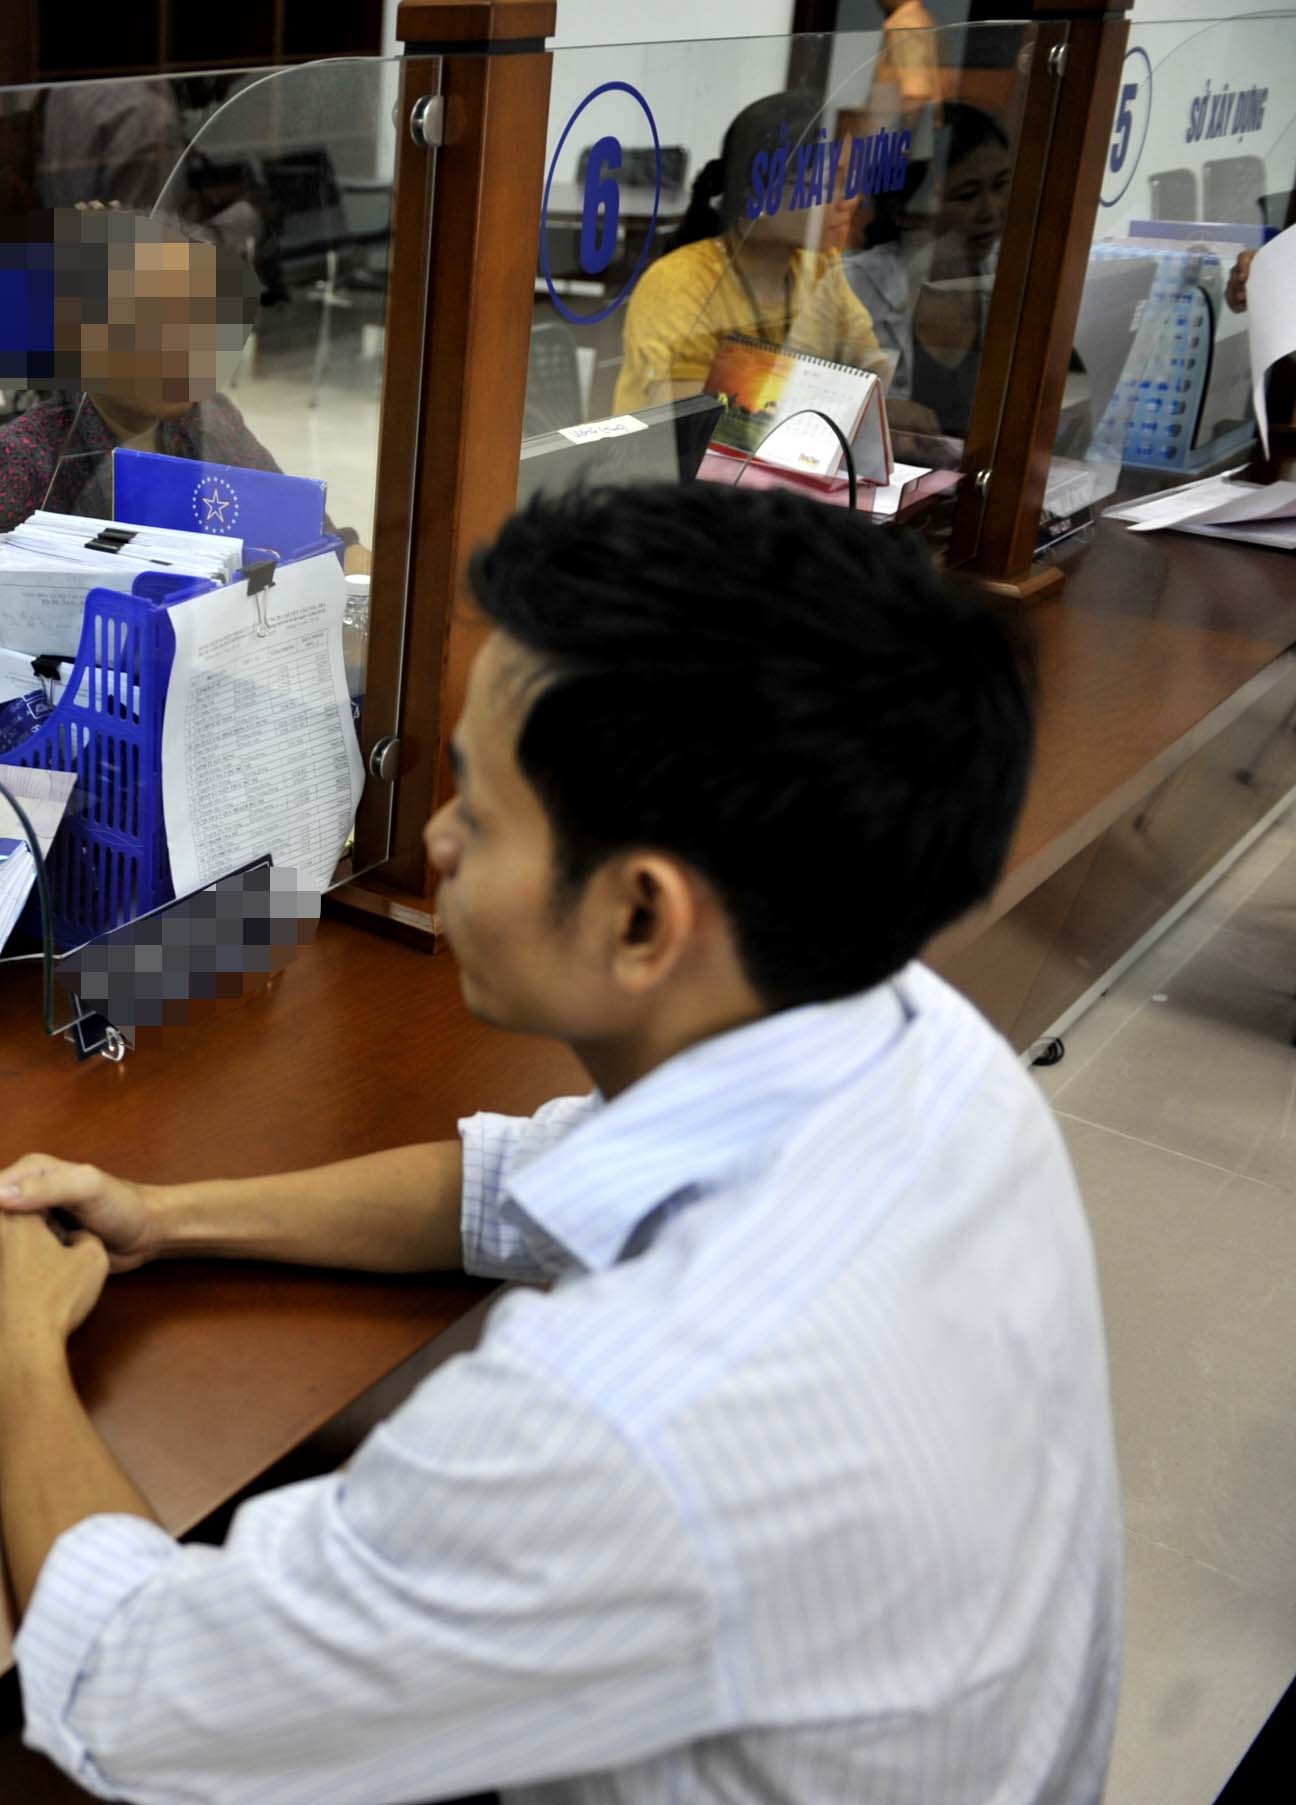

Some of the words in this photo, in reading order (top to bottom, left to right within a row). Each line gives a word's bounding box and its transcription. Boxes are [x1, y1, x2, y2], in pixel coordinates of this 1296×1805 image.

[1109, 83, 1138, 174] 5
[1185, 78, 1212, 143] SỞ
[1205, 83, 1237, 140] XÂY
[580, 136, 622, 275] 6
[746, 122, 791, 221] SỞ
[788, 128, 843, 212] XÂY
[844, 127, 913, 209] DỰNG
